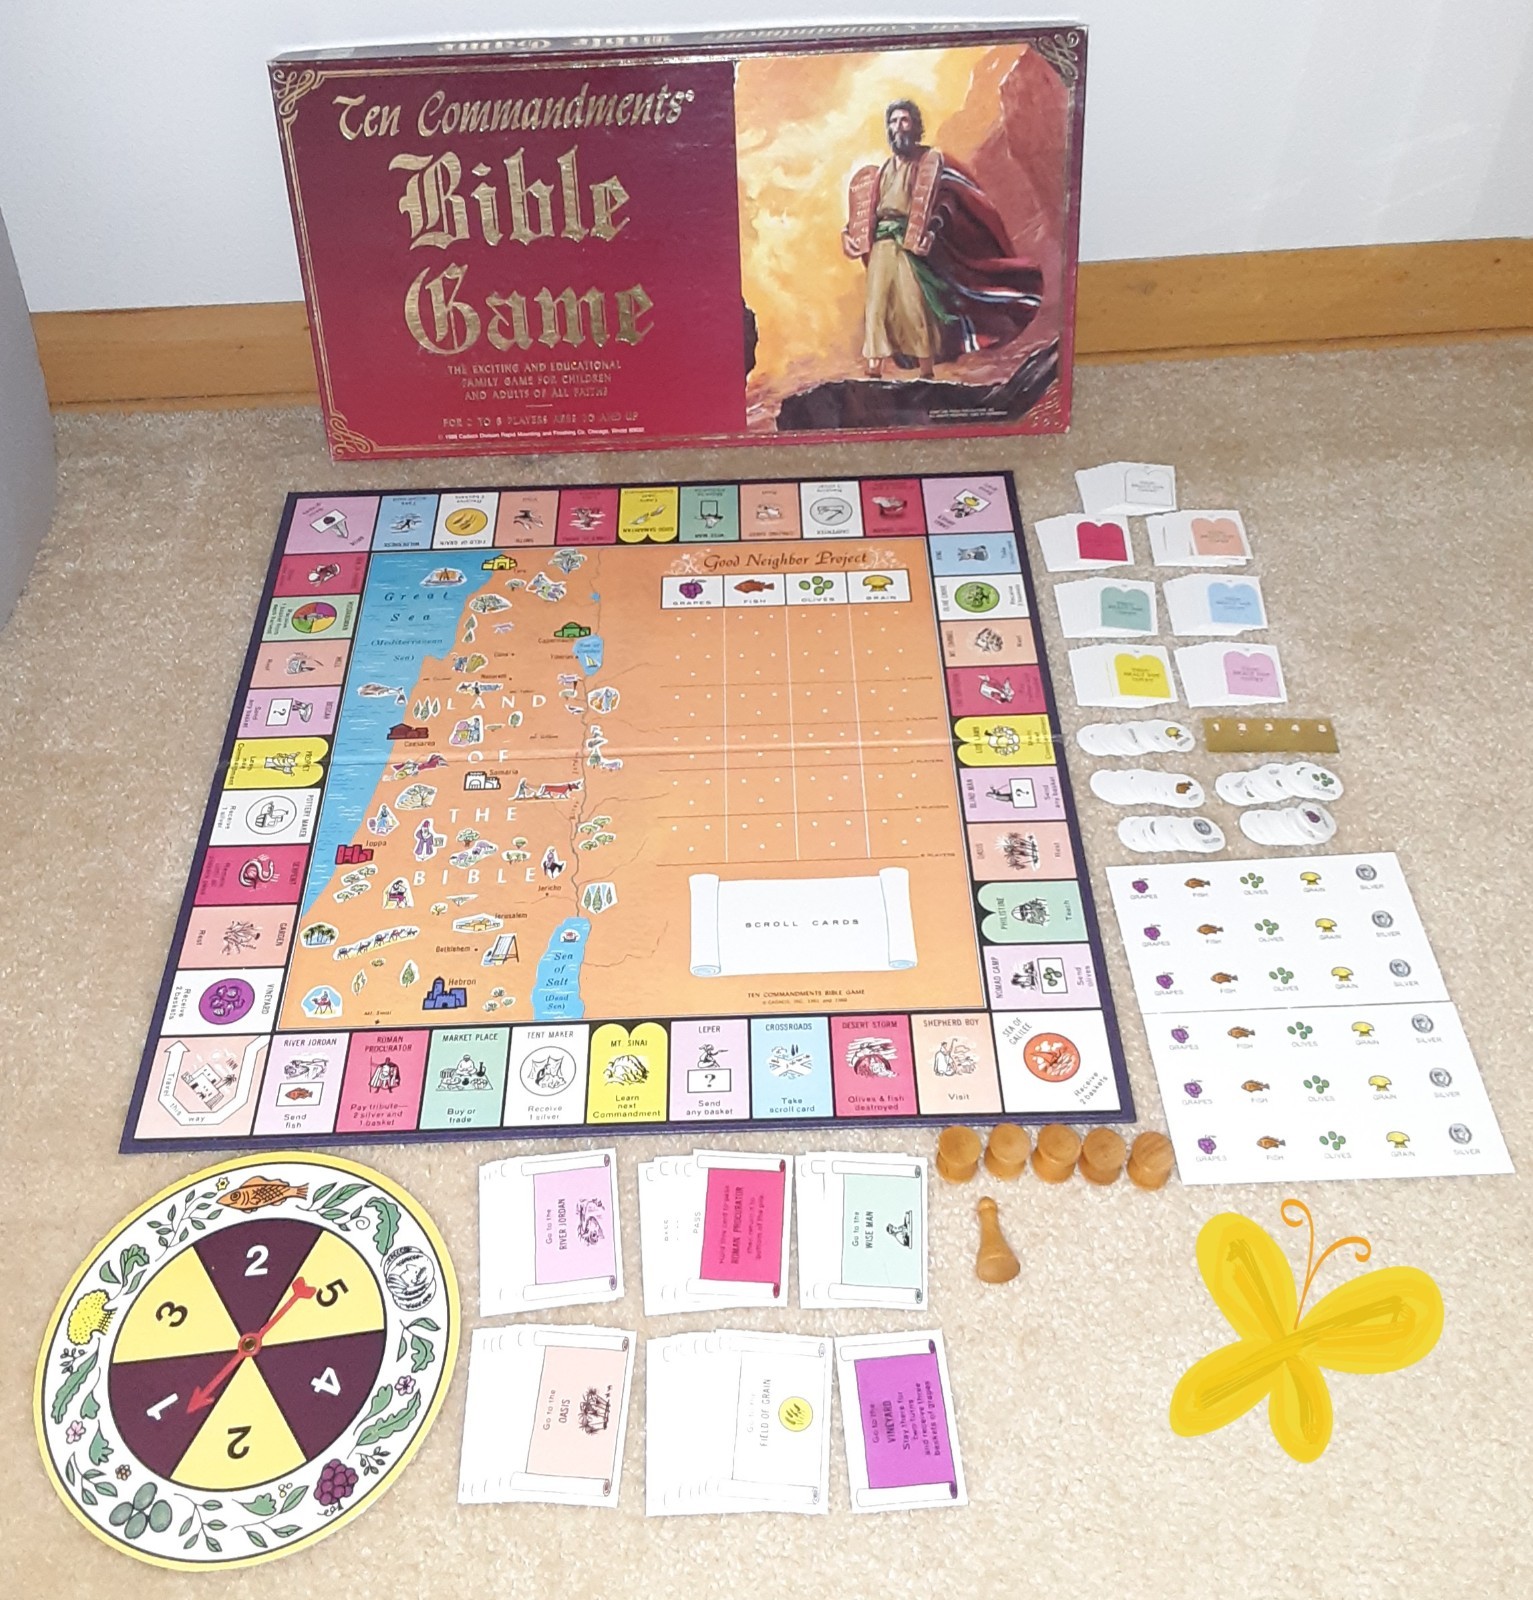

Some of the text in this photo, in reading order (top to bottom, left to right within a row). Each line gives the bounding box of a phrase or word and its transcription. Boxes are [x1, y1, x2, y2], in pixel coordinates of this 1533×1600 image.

[333, 95, 400, 140] Ten
[389, 145, 630, 250] Bible
[404, 263, 655, 355] Game
[448, 360, 622, 375] THE EXCITING AND EDUCATIONAL
[461, 374, 612, 388] FAMILY GAME FOR CHILDREN
[465, 390, 487, 400] AND
[492, 389, 529, 399] ADULTS
[533, 388, 546, 398] OF
[551, 387, 569, 397] ALL
[703, 551, 868, 571] Good Neighbor Project
[384, 591, 450, 602] Great
[390, 612, 431, 622] Sea
[447, 695, 547, 710] LAND
[467, 749, 509, 763] OF
[489, 768, 519, 776] Samaria
[225, 806, 236, 830] Receive
[299, 794, 314, 838] POTTERY MAKER
[450, 806, 517, 824] THE
[365, 838, 388, 849] Joppa
[413, 867, 536, 886] BIBLE
[537, 884, 562, 892] Jericho
[494, 911, 528, 920] Jerusalem
[996, 897, 1008, 930] PHILISTINE
[196, 929, 206, 946] Rest
[276, 922, 288, 947] GARDEN
[435, 945, 471, 953] Bethlehem
[553, 952, 573, 961] Sea
[553, 965, 565, 974] of
[990, 956, 1003, 999] NOMAD CAMP
[1076, 966, 1084, 986] Send
[1085, 965, 1094, 988] olives
[448, 977, 477, 987] Hebron
[546, 977, 569, 987] Salt
[261, 984, 275, 1015] VINEYARD
[763, 990, 822, 998] COMMANDMENTS
[169, 992, 180, 1020] baskets
[178, 988, 191, 1018] Receive
[765, 1022, 813, 1032] CROSSROADS
[842, 1020, 898, 1030] DESERT STORM
[923, 1018, 979, 1028] SHEPHERD BOY
[527, 1030, 574, 1038] TENT MAKER
[698, 1026, 721, 1034] LEPER
[1002, 1024, 1015, 1038] SEA
[1008, 1022, 1032, 1046] GALILEE
[376, 1036, 404, 1044] ROMAN
[442, 1032, 499, 1042] MARKET PLACE
[284, 1038, 337, 1048] RIVER JORDAN
[364, 1044, 412, 1053] PROCURATOR
[627, 1039, 648, 1048] SINAI
[226, 1058, 238, 1070] INN
[1074, 1071, 1098, 1097] Receive
[1084, 1075, 1108, 1100] baskets
[163, 1071, 175, 1098] Travel
[169, 1102, 182, 1117] this
[615, 1094, 640, 1102] Learn
[847, 1095, 876, 1103] Olives
[887, 1094, 905, 1102] fish
[948, 1092, 970, 1100] Visit
[618, 1102, 637, 1110] next
[698, 1100, 721, 1108] Send
[781, 1097, 803, 1105] Take
[350, 1102, 366, 1112] Pay
[527, 1105, 563, 1113] Receive
[686, 1107, 734, 1117] any basket
[769, 1104, 816, 1113] scroll card
[854, 1103, 899, 1112] destroyed
[283, 1113, 308, 1122] Send
[360, 1110, 385, 1118] silver
[387, 1110, 403, 1118] and
[447, 1108, 465, 1118] Buy
[592, 1110, 661, 1119] Commandment
[285, 1121, 302, 1129] fish
[364, 1118, 395, 1127] basket
[449, 1116, 472, 1124] trade
[558, 1198, 567, 1250] RIVER JORDAN
[866, 1210, 874, 1228] MAN
[732, 1186, 745, 1264] ROMAN PROCURATOR
[546, 1236, 552, 1245] Go
[852, 1238, 859, 1246] Go
[244, 1244, 270, 1277] 2
[315, 1277, 349, 1308] 5
[155, 1300, 189, 1329] 3
[310, 1366, 342, 1396] 4
[146, 1392, 179, 1421] 1
[546, 1405, 553, 1415] to
[558, 1398, 570, 1424] OASIS
[760, 1378, 771, 1447] FIELD OF GRAIN
[543, 1416, 551, 1430] Go
[882, 1400, 895, 1444] VINEYARD
[227, 1425, 252, 1459] 2
